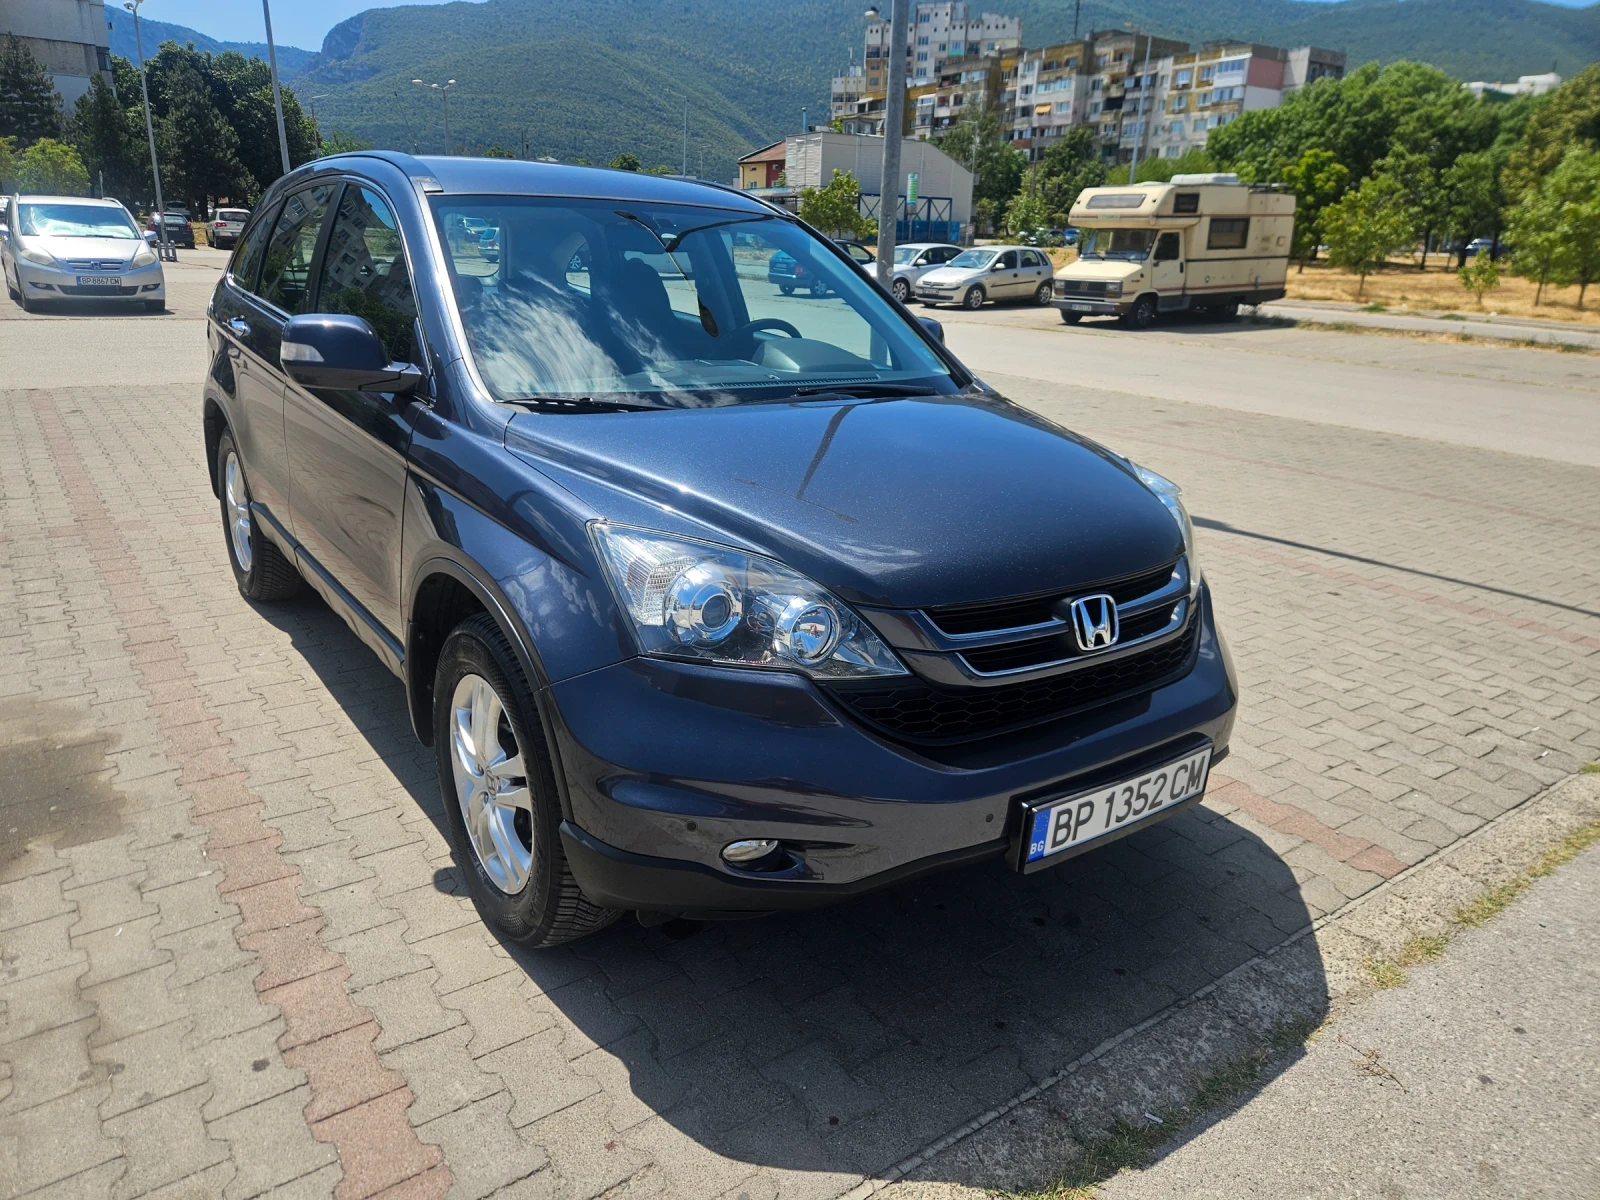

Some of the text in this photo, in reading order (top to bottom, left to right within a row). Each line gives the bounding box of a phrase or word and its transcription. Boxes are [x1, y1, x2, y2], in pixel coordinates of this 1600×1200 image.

[1051, 755, 1206, 849] BP 1352 CM
[1030, 840, 1045, 855] BG
